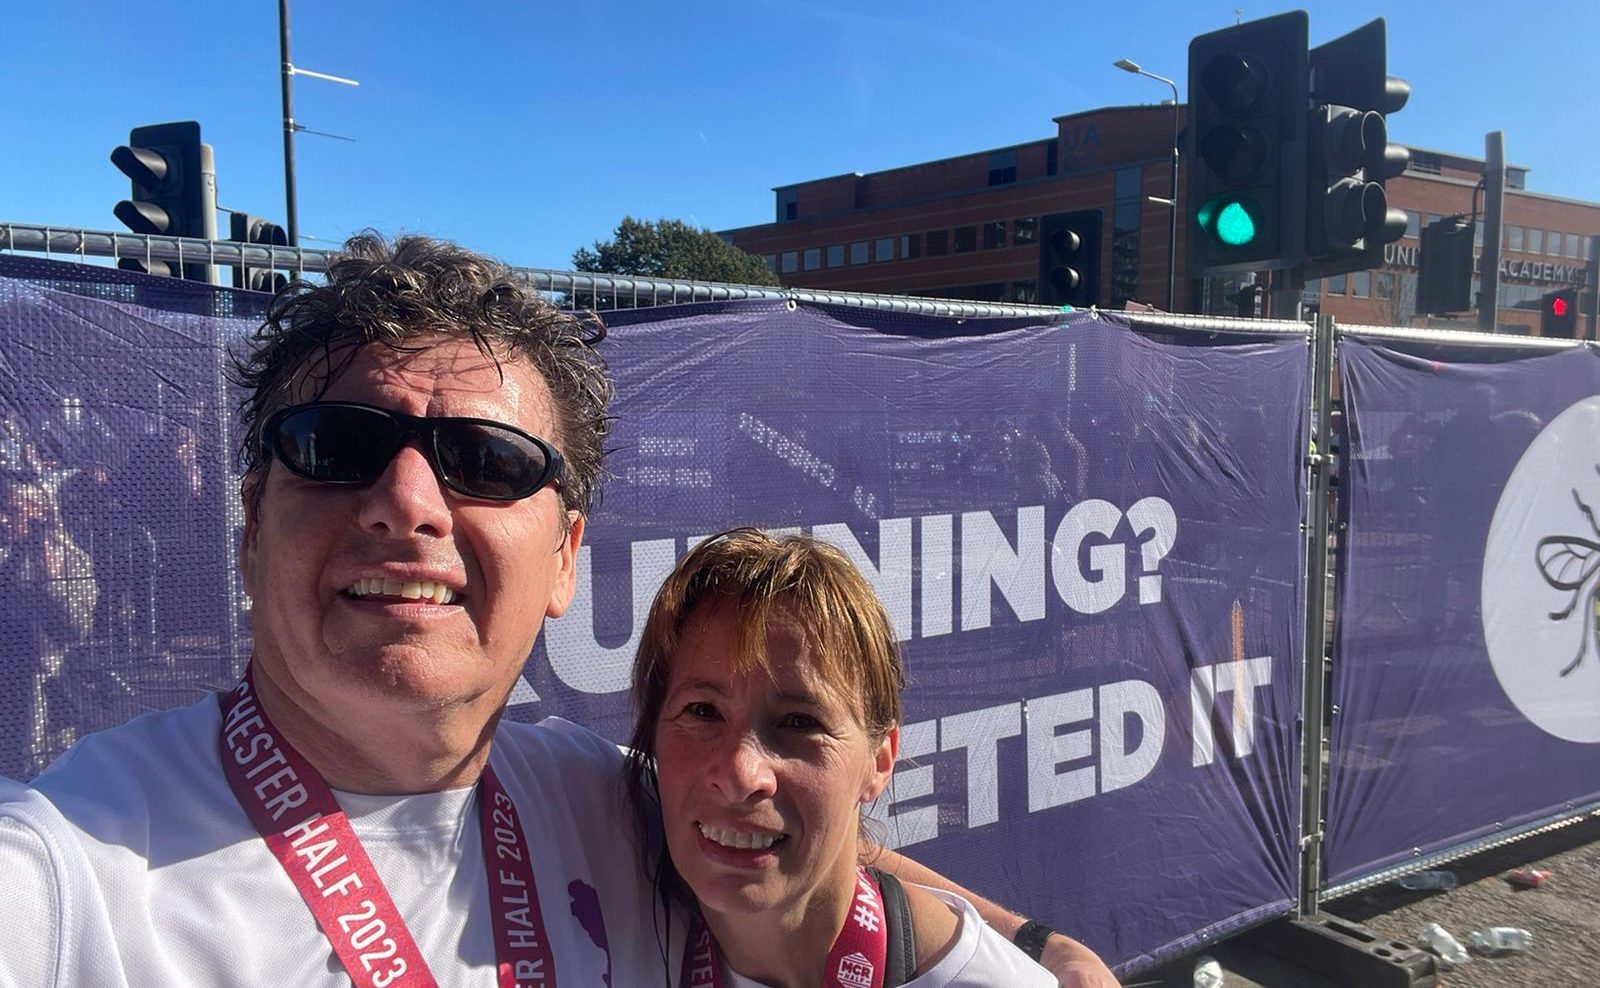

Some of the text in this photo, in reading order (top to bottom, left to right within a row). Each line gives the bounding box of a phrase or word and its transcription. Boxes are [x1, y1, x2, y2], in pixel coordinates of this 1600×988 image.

[1498, 258, 1573, 282] ACADEMY
[861, 656, 1272, 850] ETED IT
[225, 672, 408, 988] CHESTER HALF 2023
[492, 791, 522, 862] 2023
[500, 870, 538, 949] HALF
[841, 960, 872, 979] MCR
